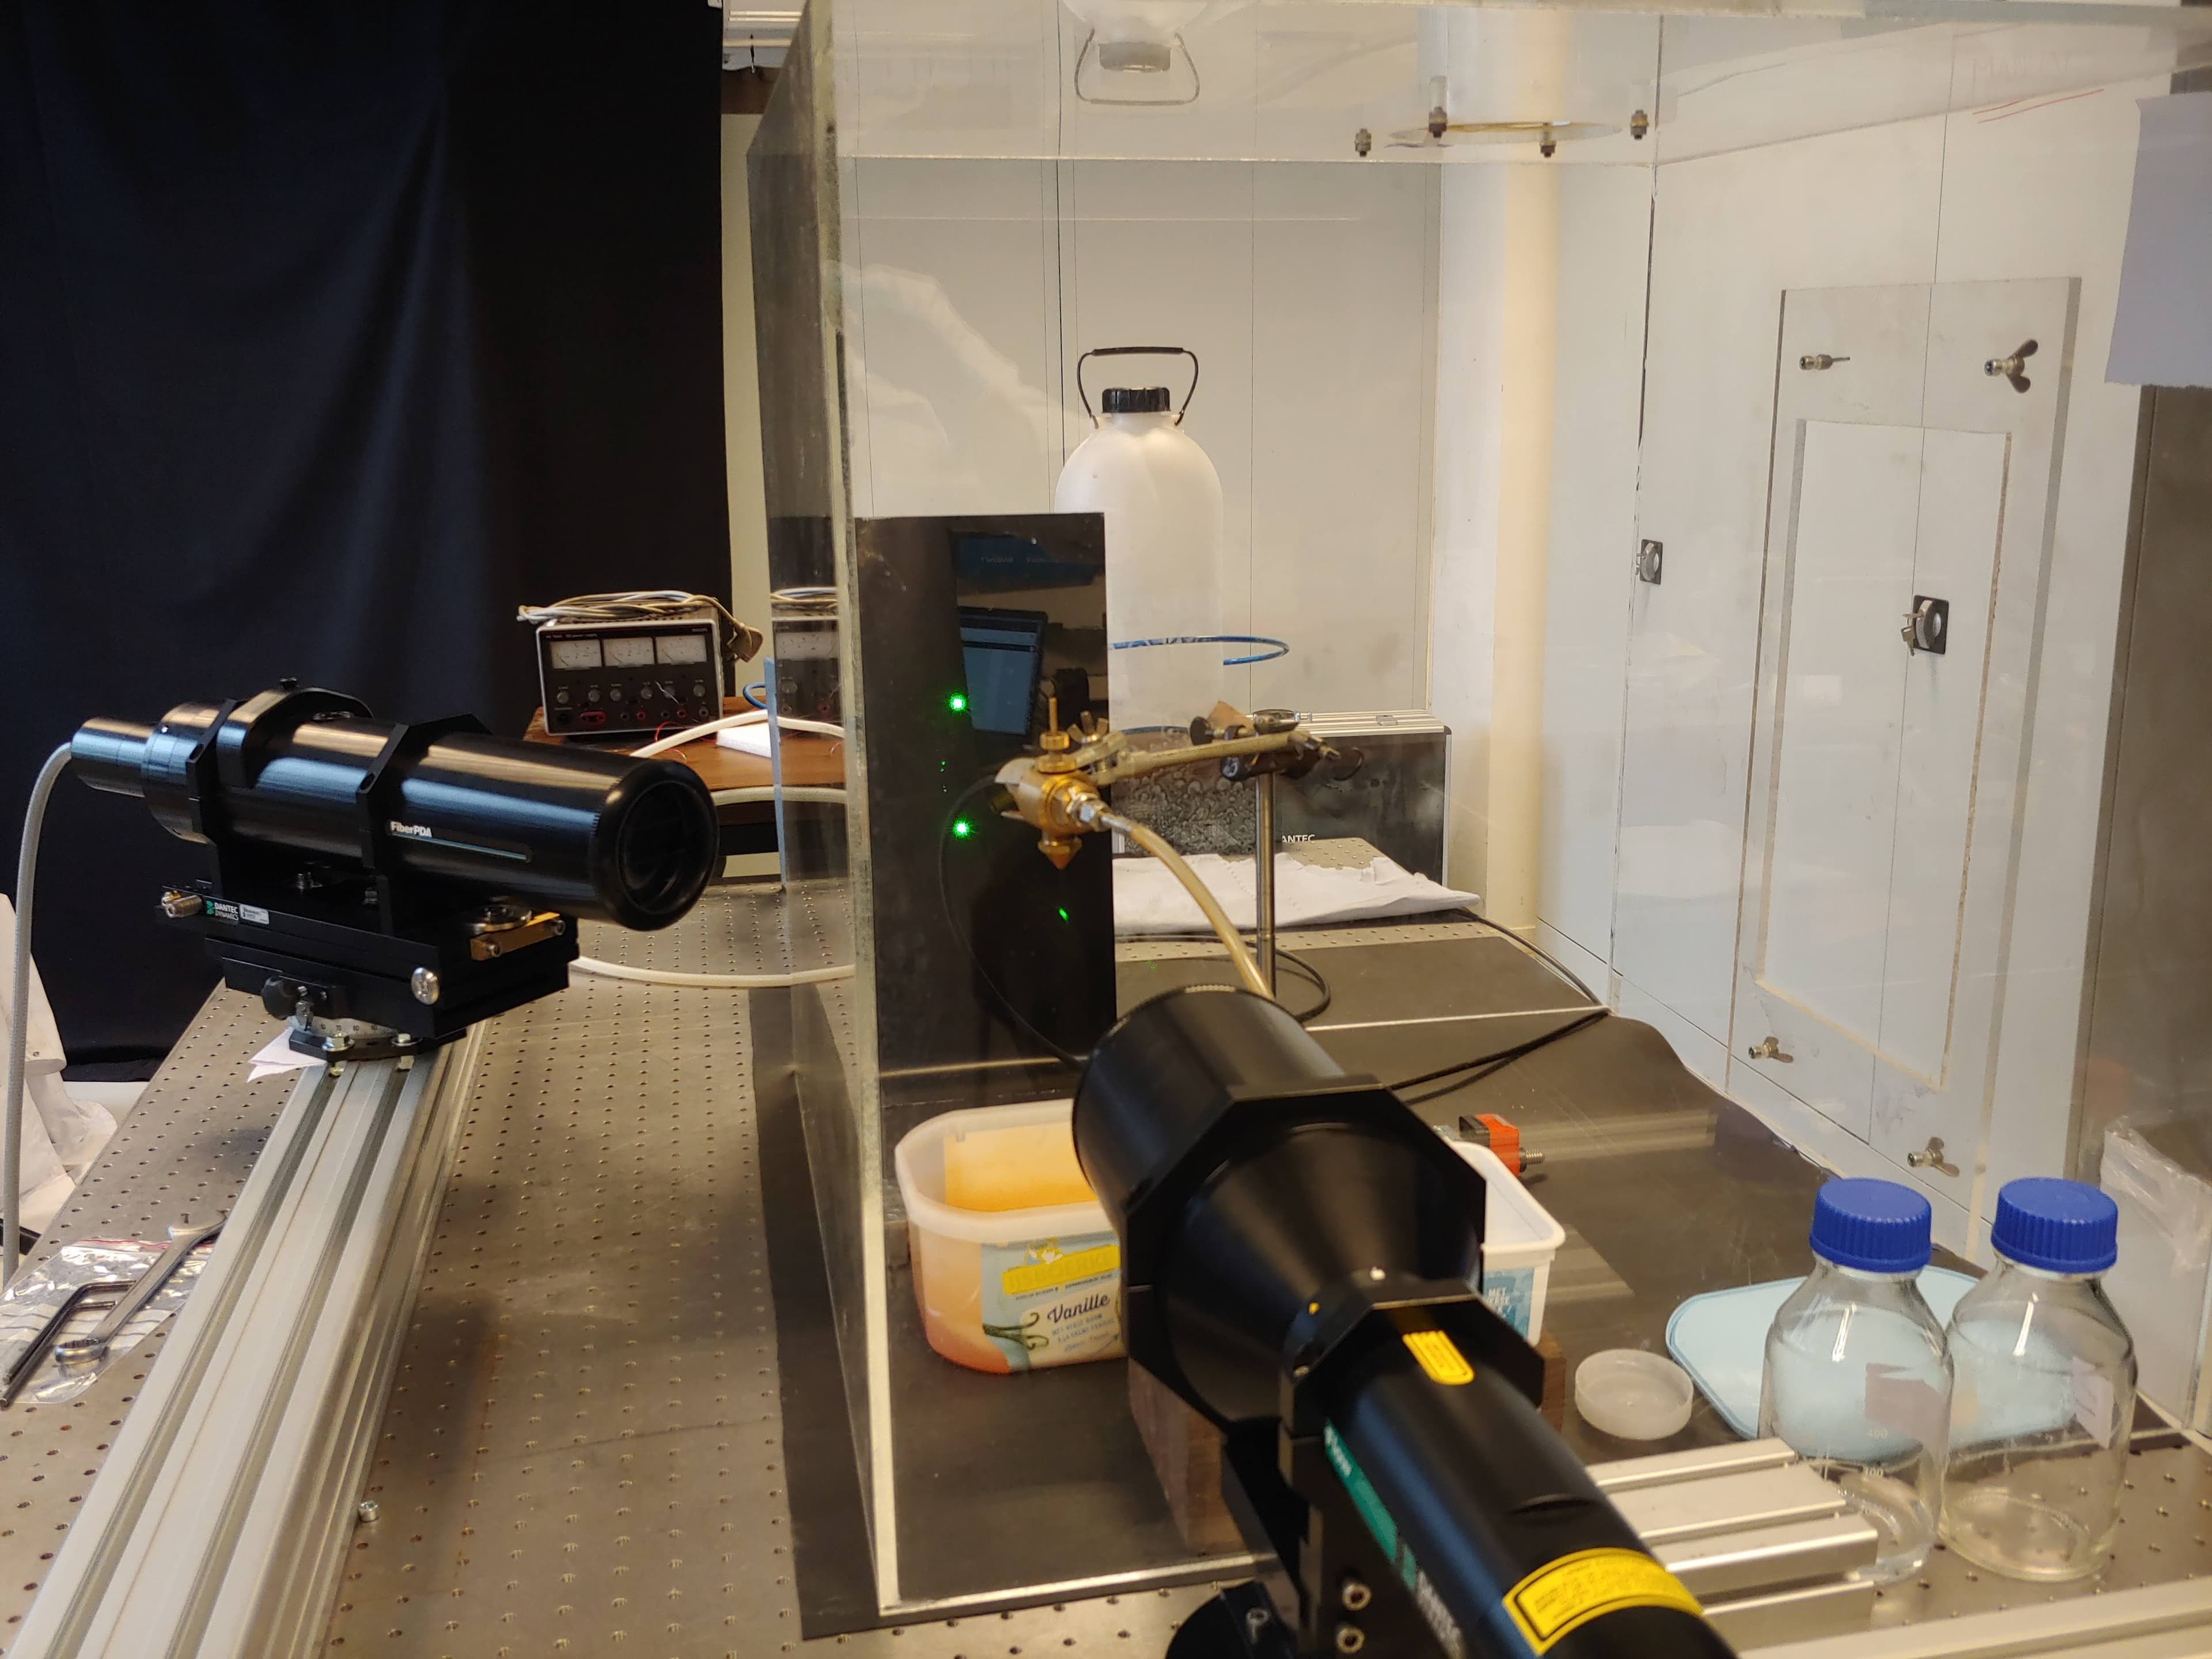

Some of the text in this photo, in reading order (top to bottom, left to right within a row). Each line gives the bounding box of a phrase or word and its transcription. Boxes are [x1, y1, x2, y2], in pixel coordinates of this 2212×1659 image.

[390, 821, 433, 838] FiberPDA
[214, 902, 238, 914] DANTEC
[215, 910, 239, 921] DYNAMICS
[1047, 1294, 1110, 1323] Vanille
